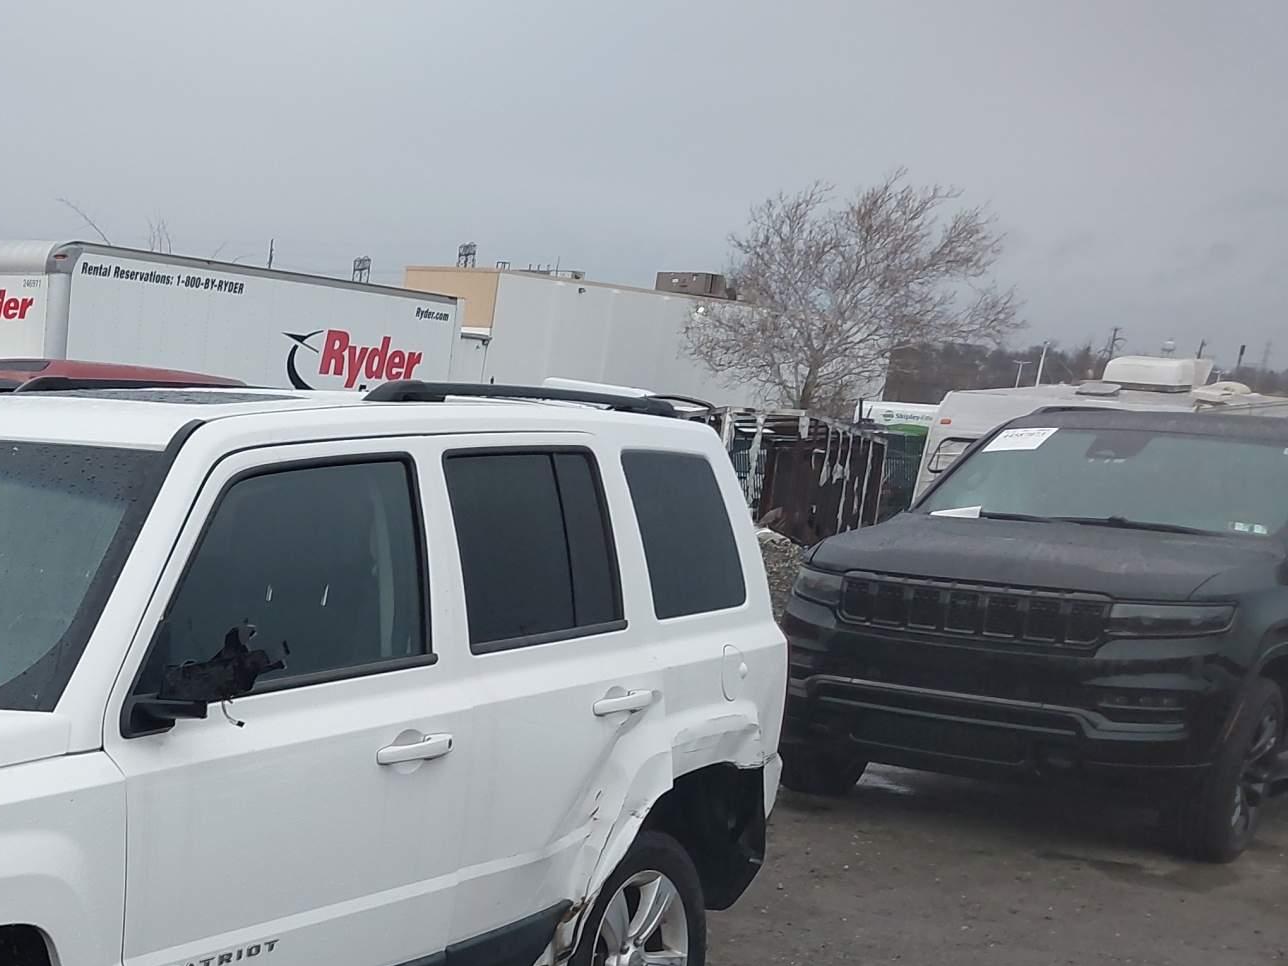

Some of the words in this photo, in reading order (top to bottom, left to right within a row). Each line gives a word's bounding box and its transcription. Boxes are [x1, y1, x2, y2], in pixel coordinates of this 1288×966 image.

[81, 262, 112, 278] Rental
[113, 266, 174, 286] Reservations:
[176, 275, 245, 295] 1-800-BY-RYDER
[415, 307, 450, 321] Ryder.com
[319, 329, 423, 389] Ryder
